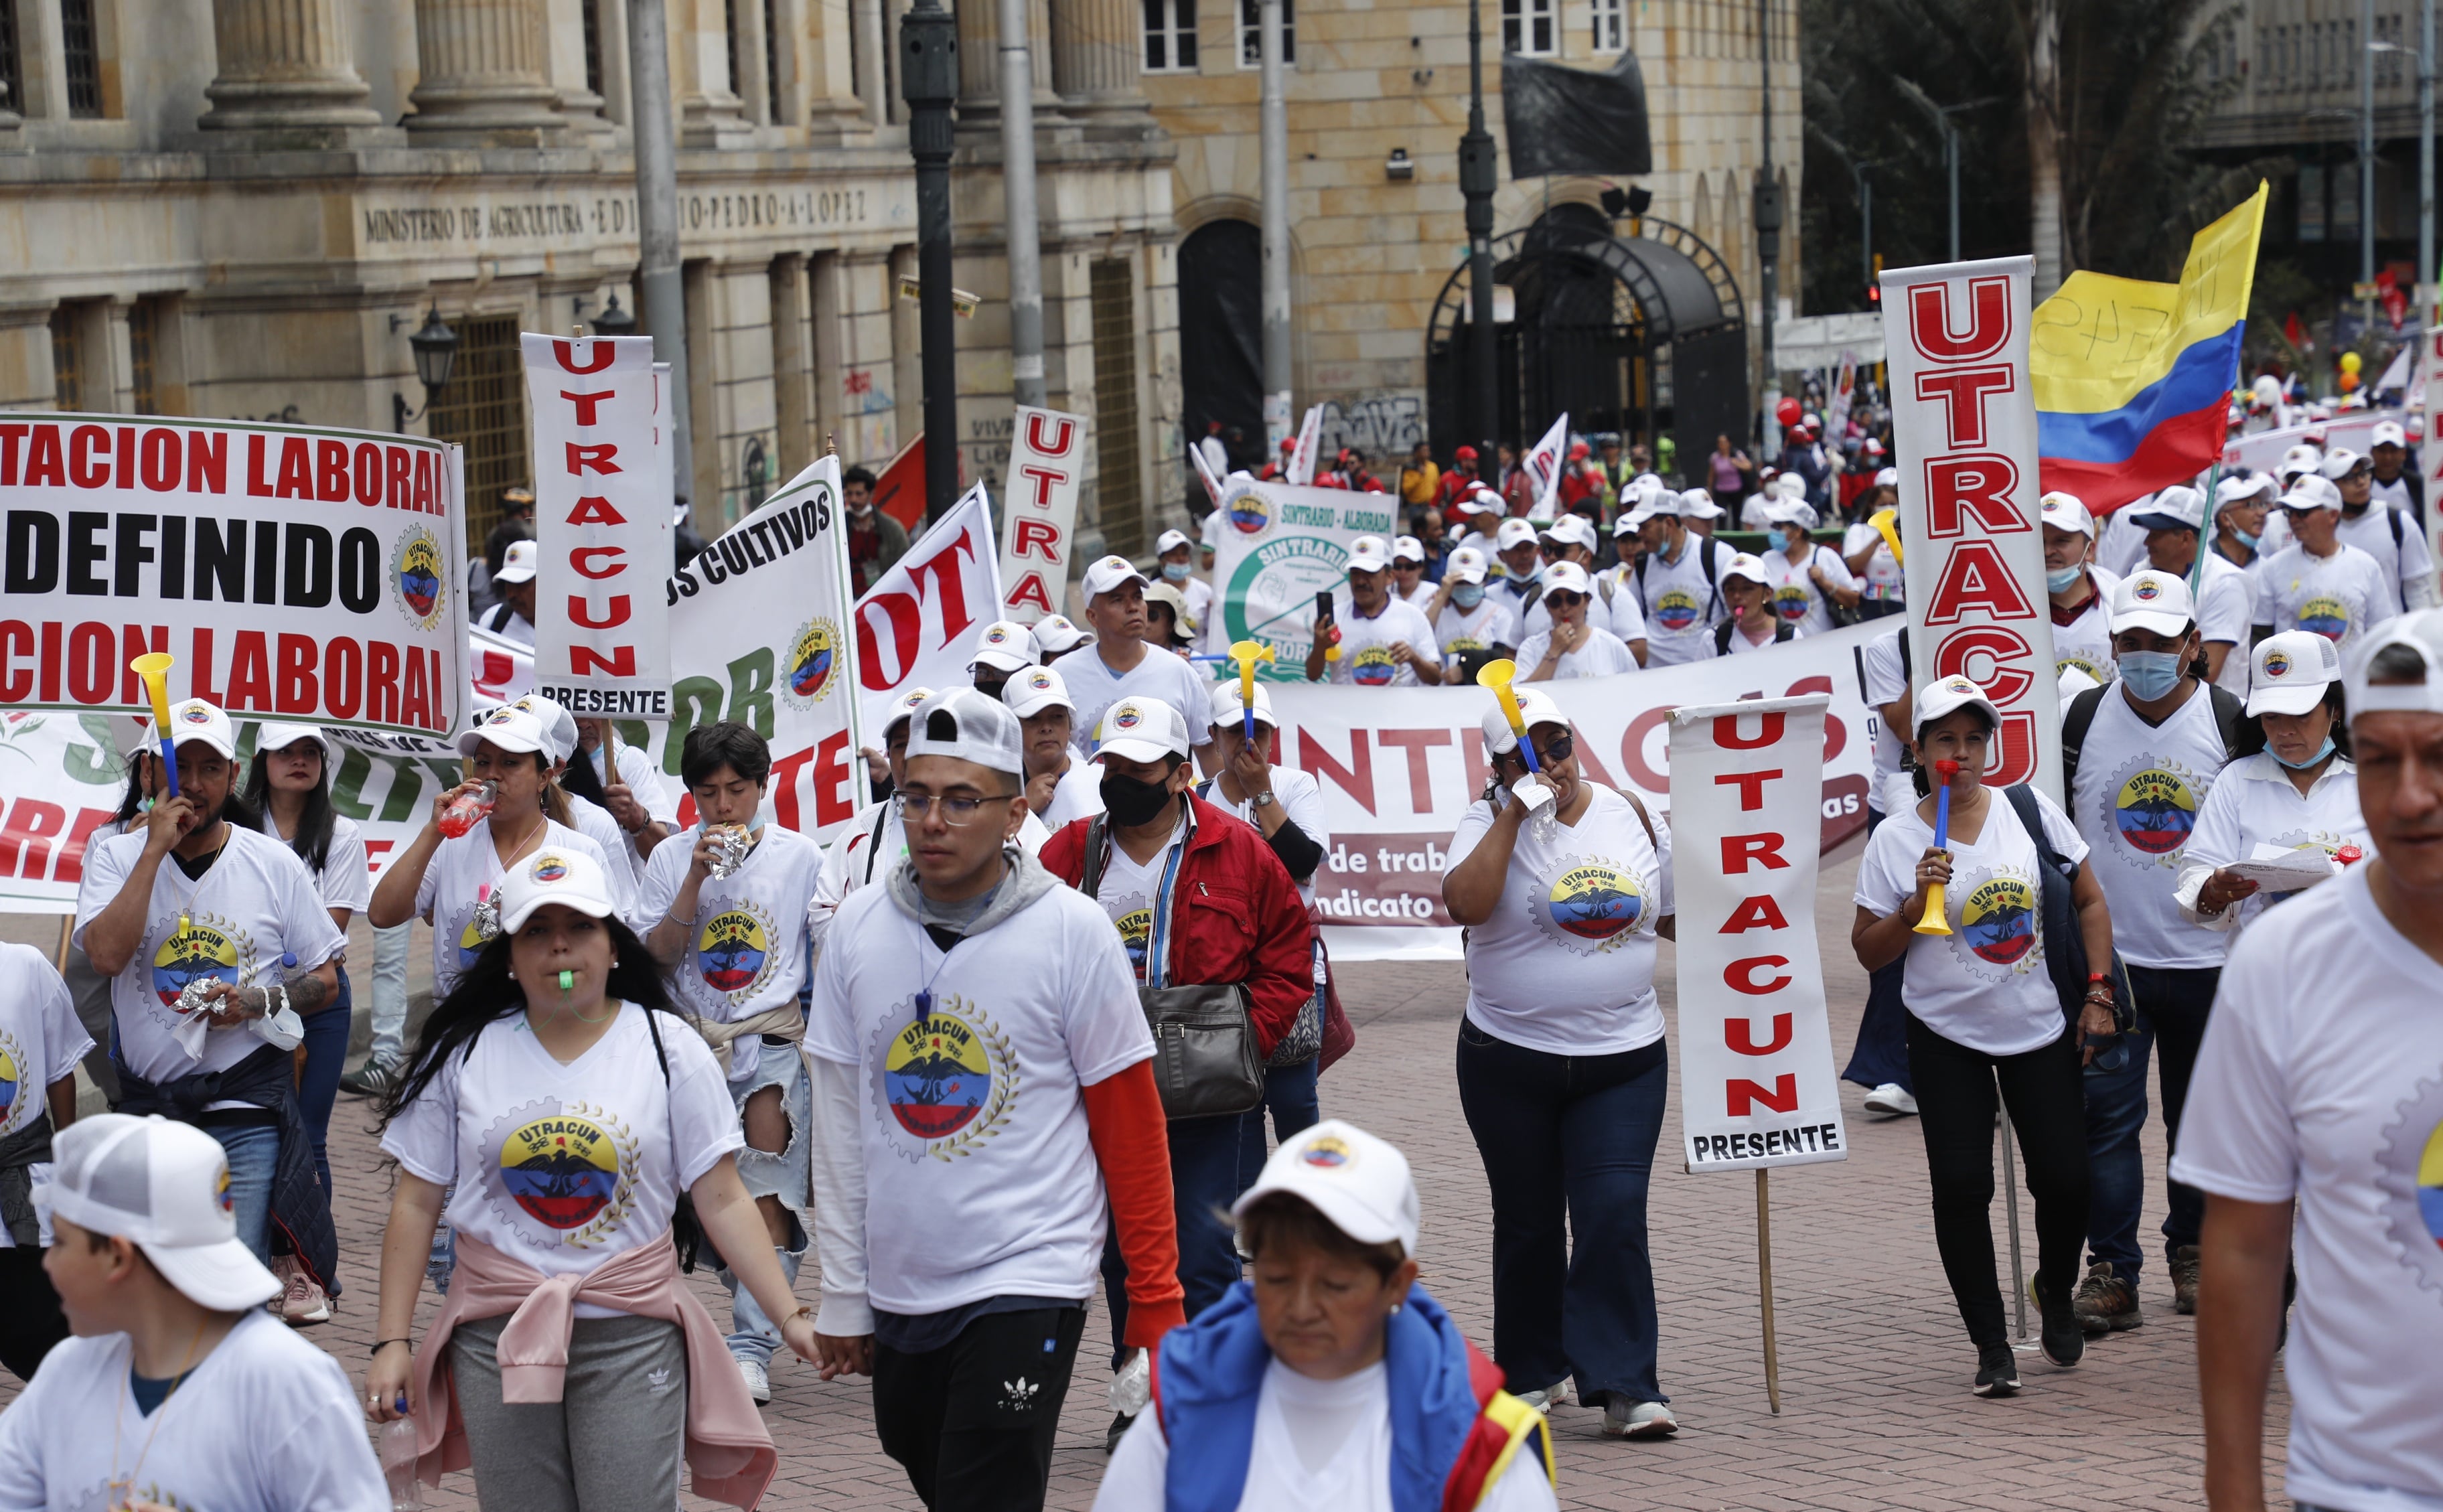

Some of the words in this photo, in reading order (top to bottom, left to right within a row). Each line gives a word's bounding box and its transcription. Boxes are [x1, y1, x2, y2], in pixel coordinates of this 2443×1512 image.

[366, 208, 455, 243] MINISTERIO
[461, 207, 481, 240] DE
[488, 202, 583, 238] AGRICULTURA
[246, 434, 445, 517] LABORAL
[552, 339, 636, 677] UTRACUN
[1004, 412, 1076, 628] UTRA
[1280, 504, 1335, 528] SINTRARIO
[1342, 510, 1392, 534] ALBORADA
[409, 543, 434, 560] UTRACUN
[699, 490, 830, 585] CULTIVOS
[4, 510, 381, 614] DEFINIDO
[796, 631, 823, 656] UTRACUN
[190, 627, 447, 731] LABORAL
[542, 686, 666, 714] PRESENTE
[2130, 772, 2181, 793] UTRACUN
[1328, 842, 1367, 873] de
[1562, 868, 1617, 887] UTRACUN
[1315, 888, 1434, 919] ndicato
[1970, 881, 2025, 906] UTRACUN
[708, 915, 756, 933] UTRACUN
[1712, 711, 1799, 1118] UTRACUN
[903, 1019, 970, 1046] UTRACUN
[518, 1121, 601, 1144] UTRACUN
[1692, 1123, 1840, 1162] PRESENTE
